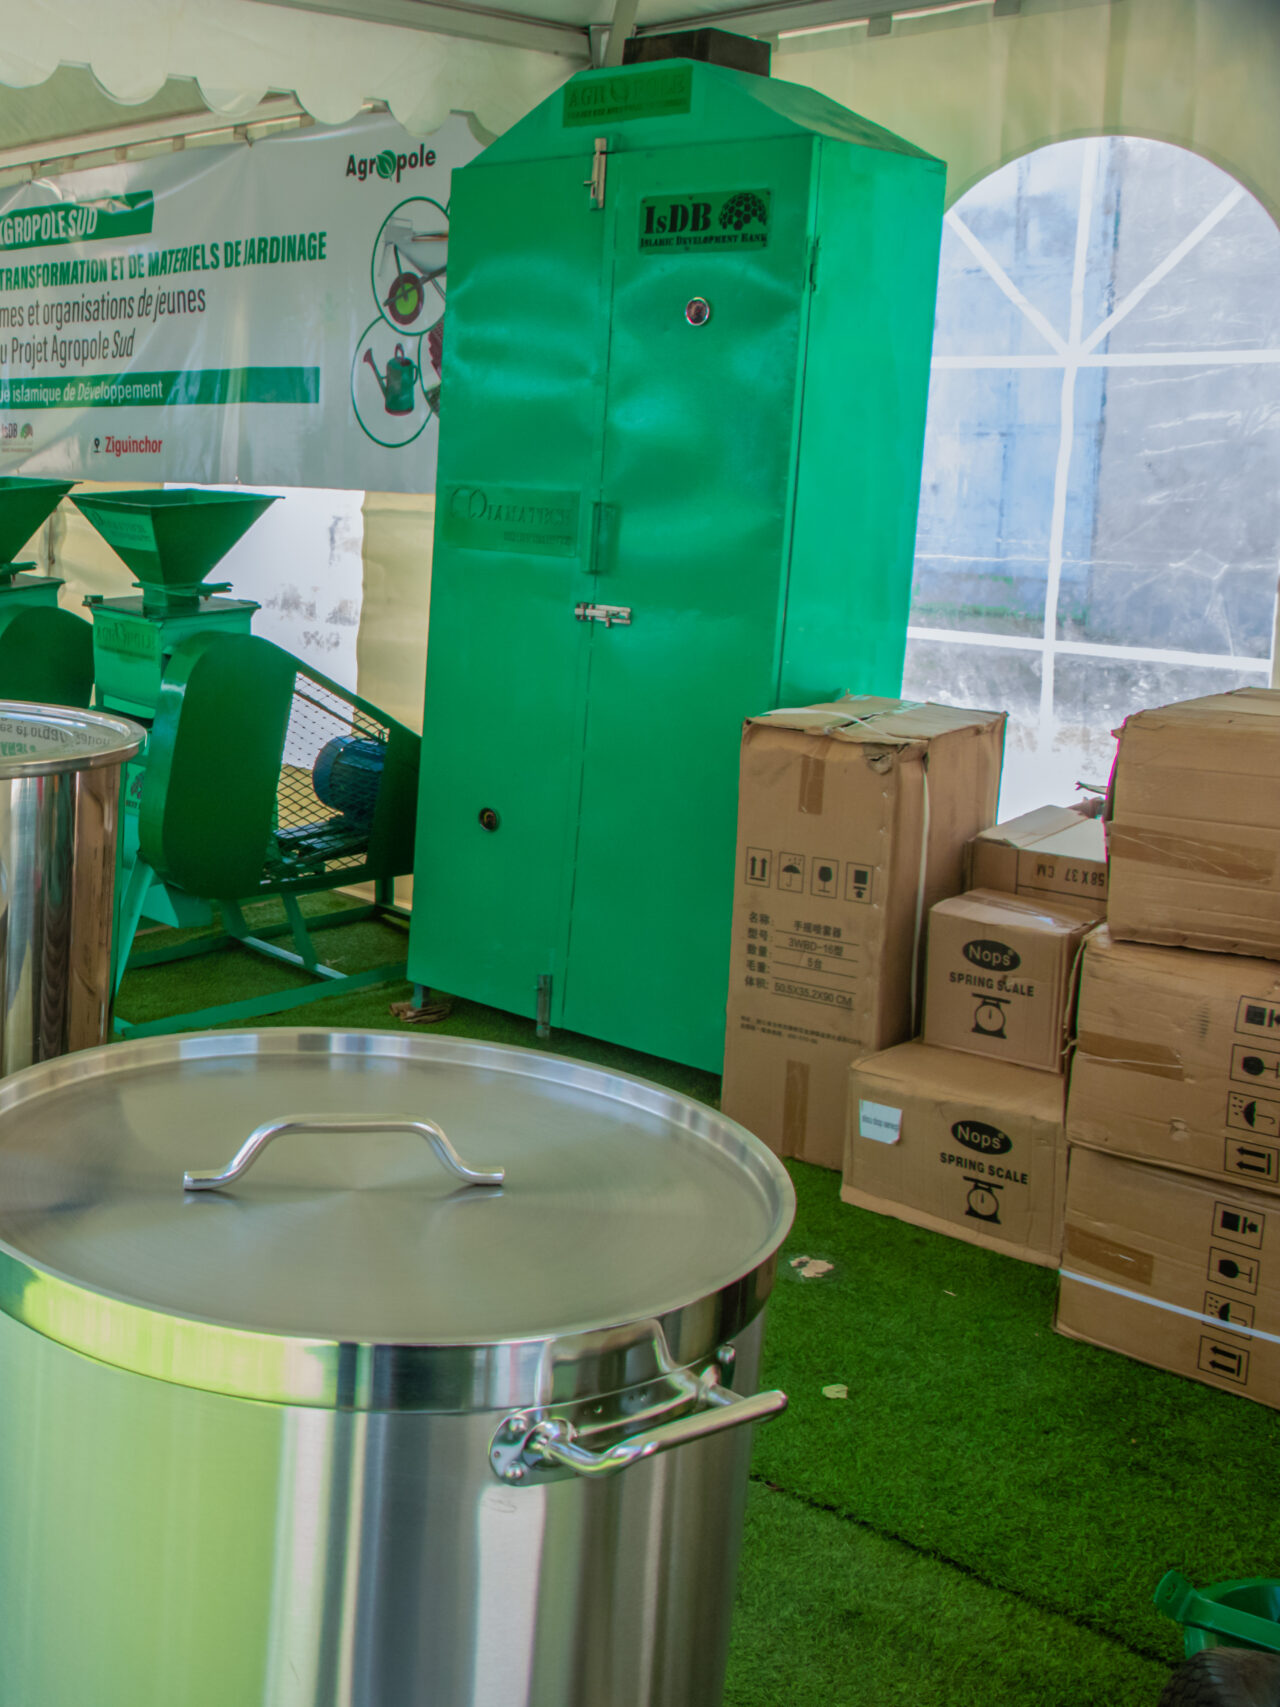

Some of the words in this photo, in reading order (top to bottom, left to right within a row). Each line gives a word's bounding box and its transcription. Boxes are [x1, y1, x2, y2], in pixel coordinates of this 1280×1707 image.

[346, 142, 436, 184] Agropole
[68, 207, 98, 237] SUD
[644, 202, 712, 234] IsDB
[111, 256, 125, 281] ET
[128, 253, 145, 279] DE
[148, 242, 220, 277] MATERIELS
[223, 240, 242, 268] DE
[242, 231, 327, 266] JARDINAGE
[27, 299, 40, 326] et
[43, 291, 135, 331] organisations
[137, 287, 153, 317] de
[152, 285, 206, 323] jeunes
[11, 333, 48, 370] Projet
[51, 330, 109, 369] Agropole
[111, 327, 136, 359] Sud
[12, 384, 61, 406] islamique
[63, 382, 75, 400] de
[77, 379, 163, 404] Développement
[104, 435, 163, 458] Ziguinchor
[949, 971, 994, 989] SPRING
[997, 978, 1035, 997] SCALE
[835, 994, 853, 1007] CM
[940, 1152, 985, 1174] SPRING
[988, 1164, 1028, 1185] SCALE
